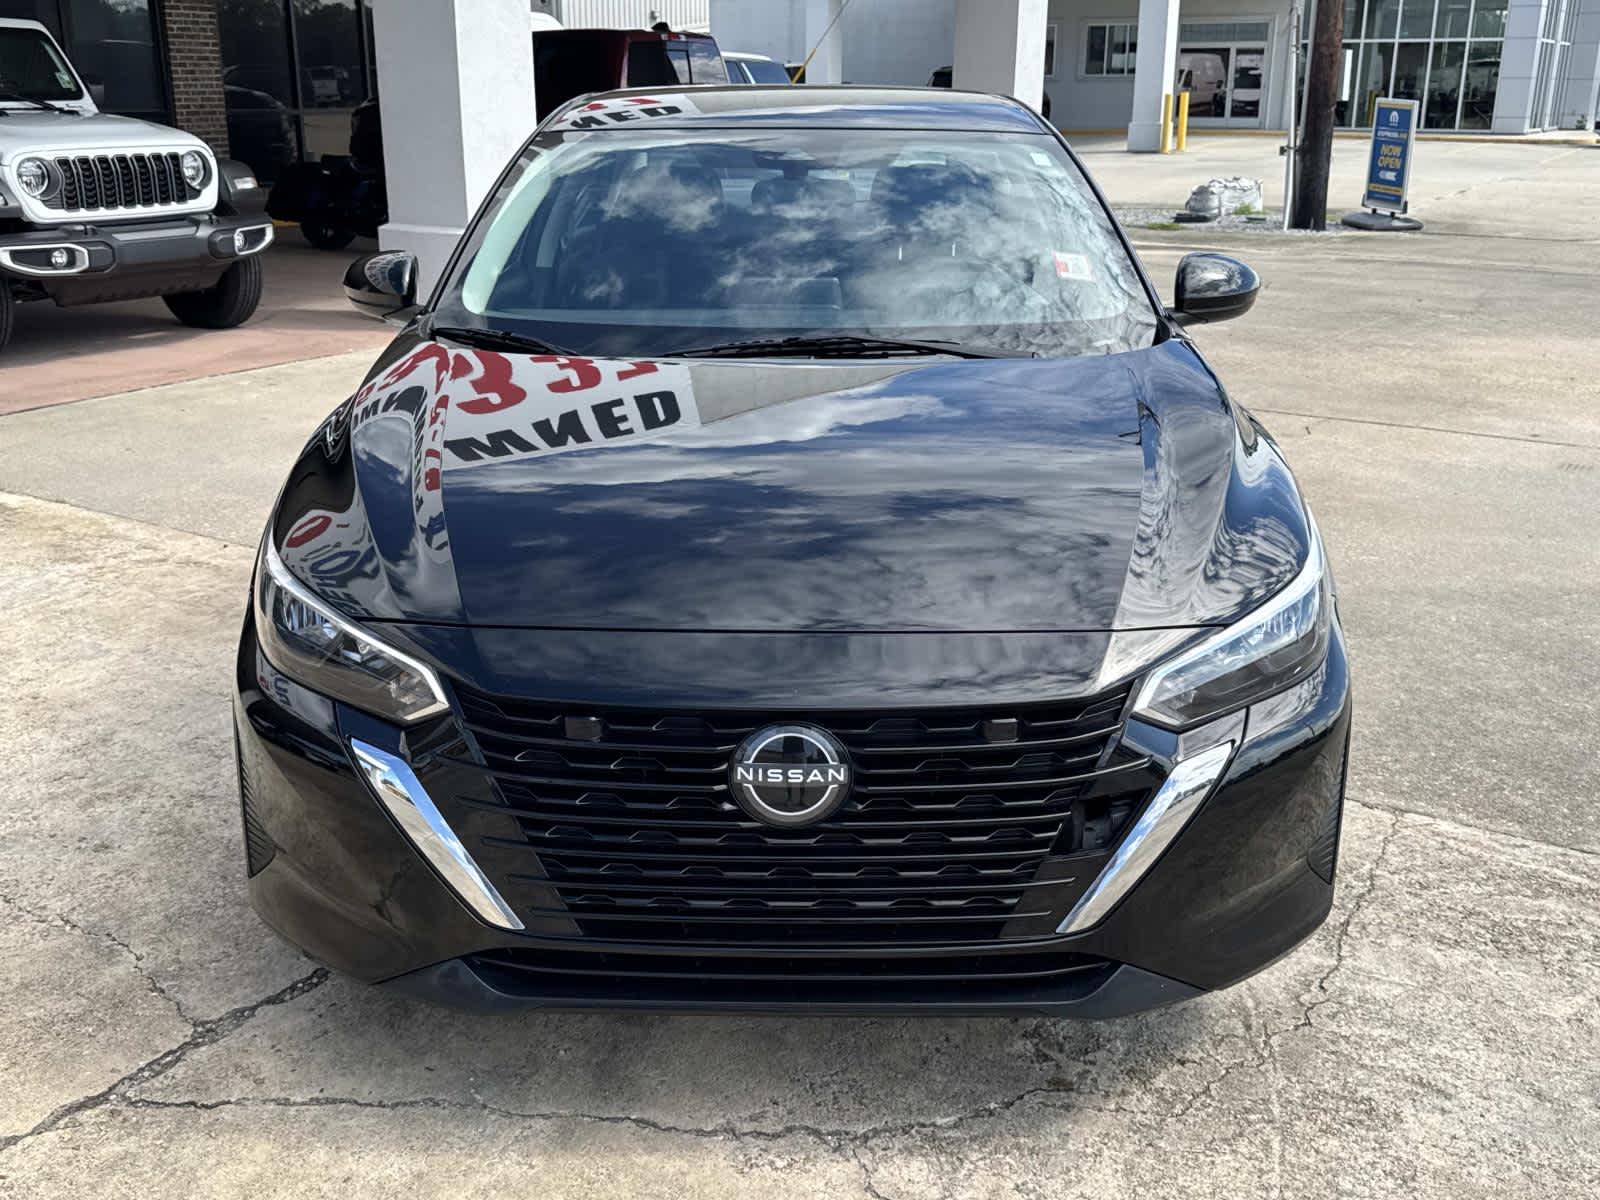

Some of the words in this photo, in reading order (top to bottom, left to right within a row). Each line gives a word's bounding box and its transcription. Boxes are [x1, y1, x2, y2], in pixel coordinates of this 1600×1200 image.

[1380, 144, 1402, 157] NOW
[1378, 156, 1402, 169] OPEN
[736, 766, 845, 783] NISSAN
